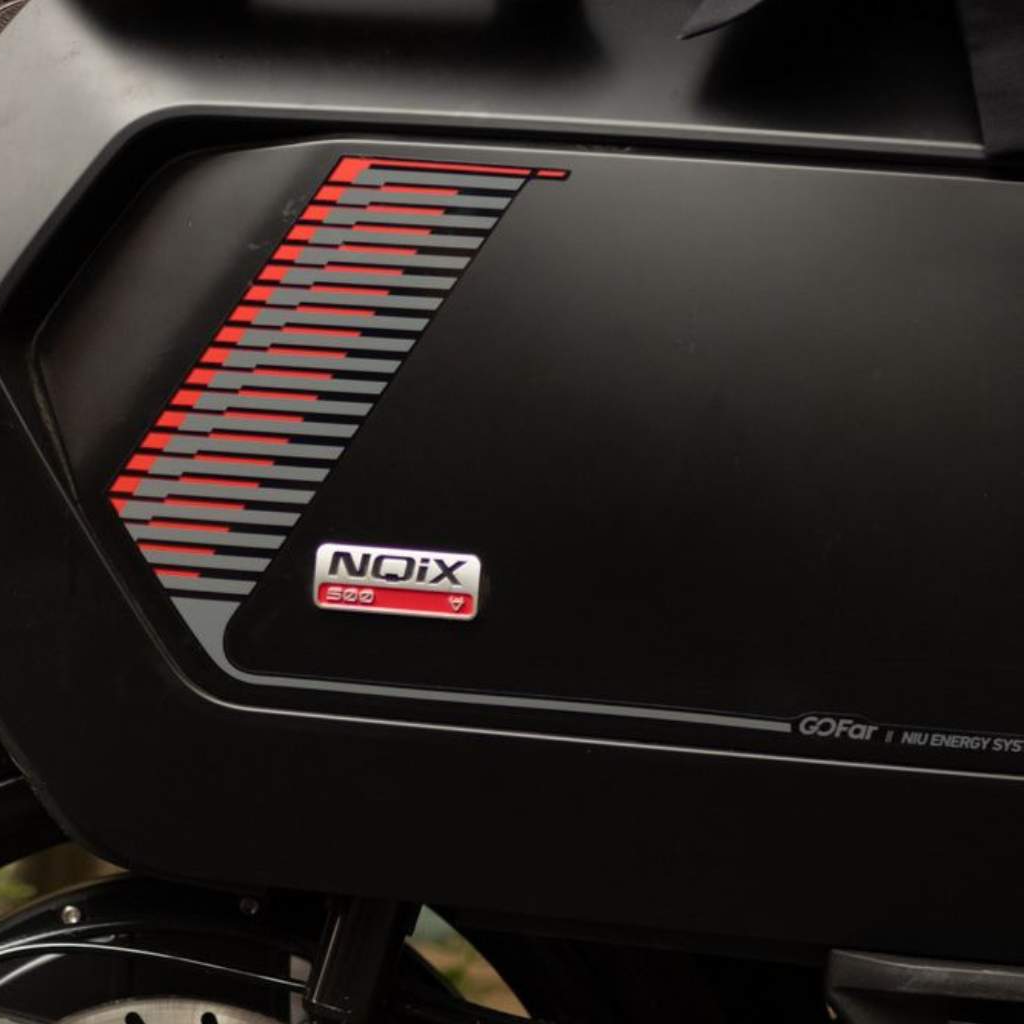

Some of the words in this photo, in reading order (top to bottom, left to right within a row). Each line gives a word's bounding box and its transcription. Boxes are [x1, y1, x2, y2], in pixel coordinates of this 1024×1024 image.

[327, 551, 467, 585] NQiX
[326, 586, 374, 604] 500
[799, 716, 878, 740] GOFar
[900, 731, 928, 745] NIU
[930, 733, 990, 750] ENERGY
